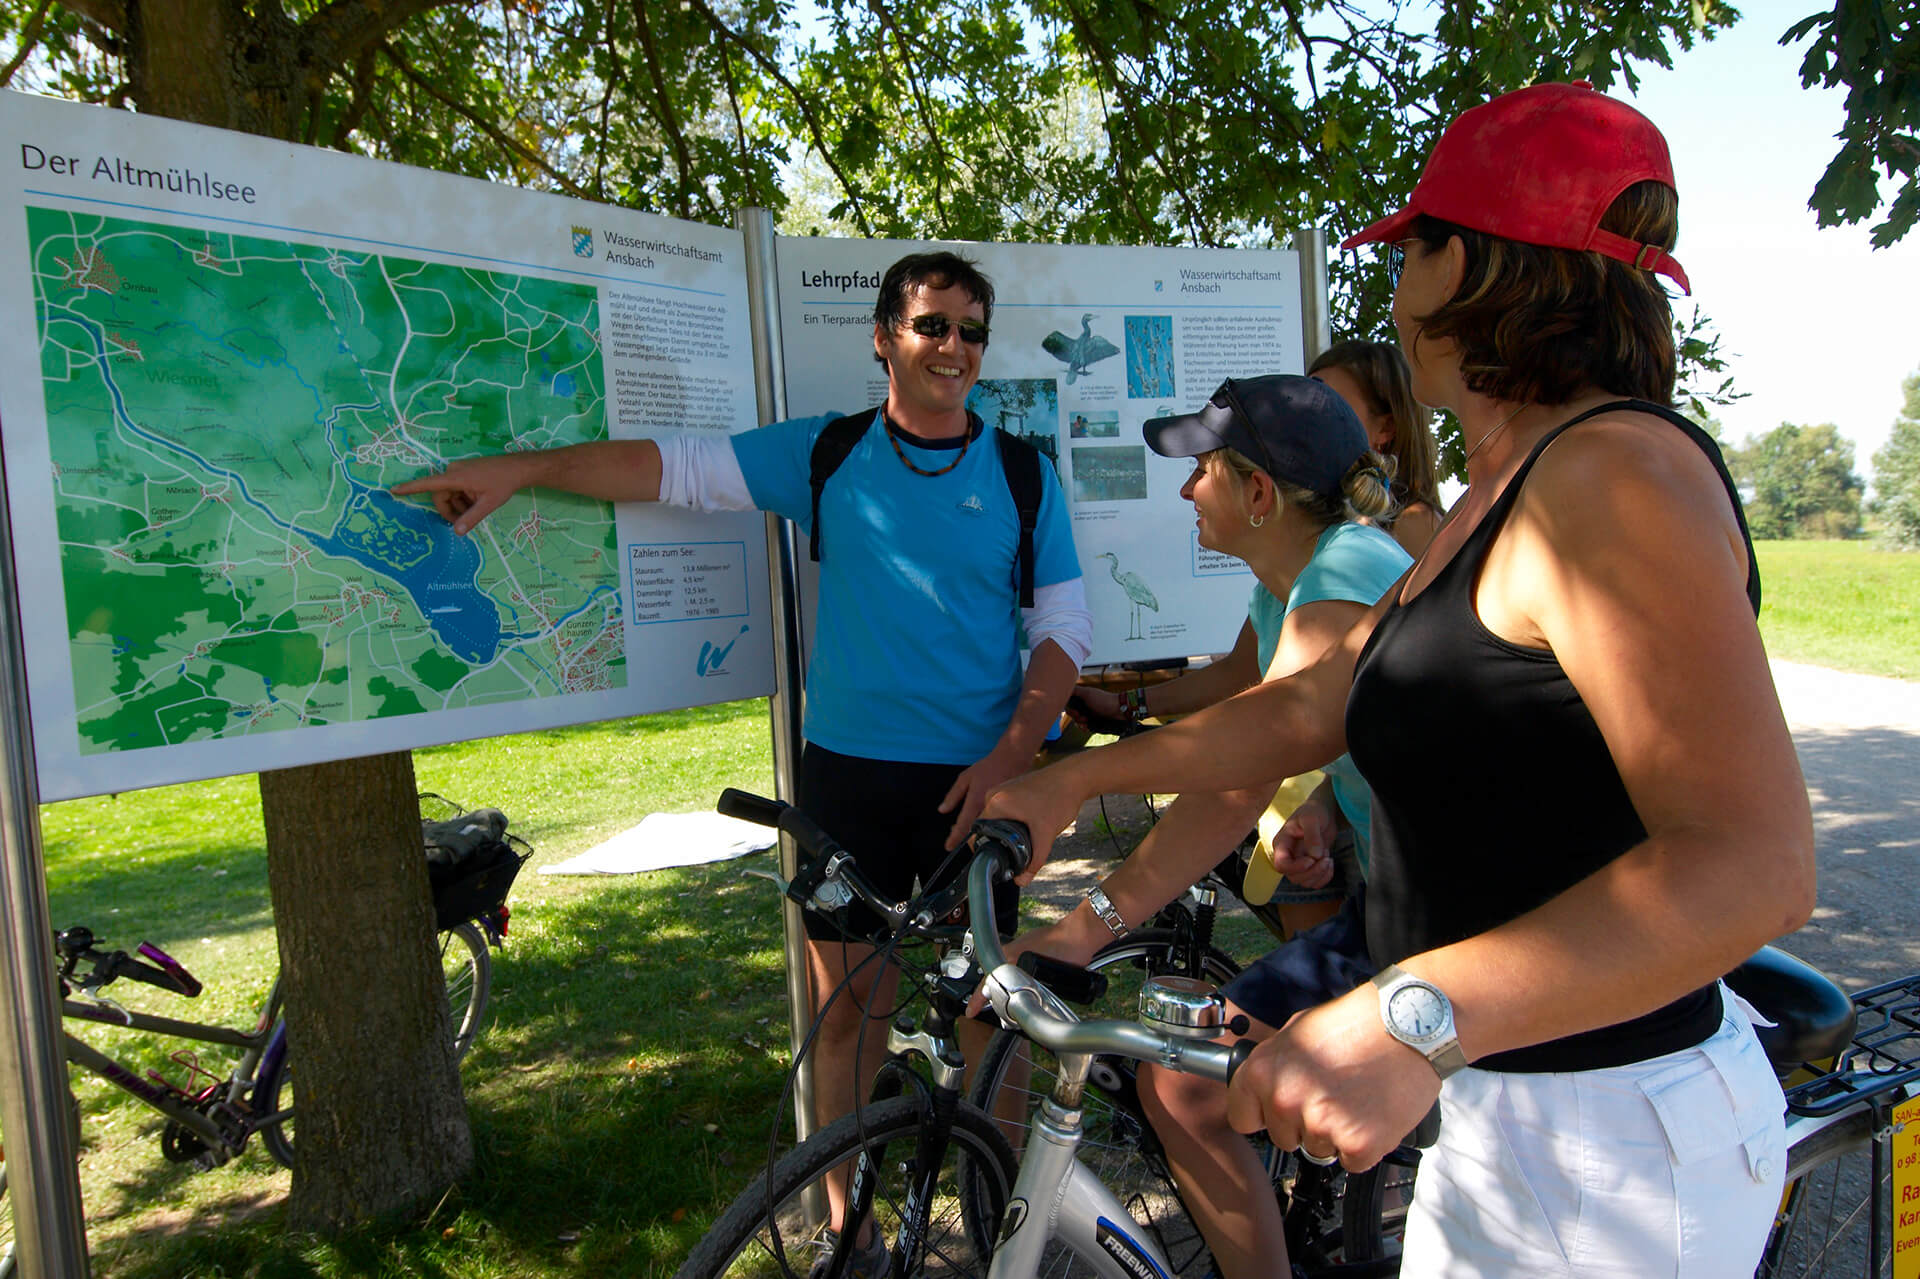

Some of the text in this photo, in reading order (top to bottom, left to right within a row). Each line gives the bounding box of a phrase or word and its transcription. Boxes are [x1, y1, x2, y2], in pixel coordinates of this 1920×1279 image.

[21, 143, 257, 205] Der Altmühlsee
[603, 230, 723, 263] Wasserwirtschaftsamt
[606, 250, 654, 269] Ansbach
[1179, 269, 1281, 281] Wasserwirtschaftsamt
[801, 270, 880, 293] Lehrpfad
[1180, 282, 1221, 294] Ansbach
[804, 314, 876, 326] Ein Tierparadie
[633, 548, 659, 559] Zahlen
[427, 581, 474, 591] Altmühlsee
